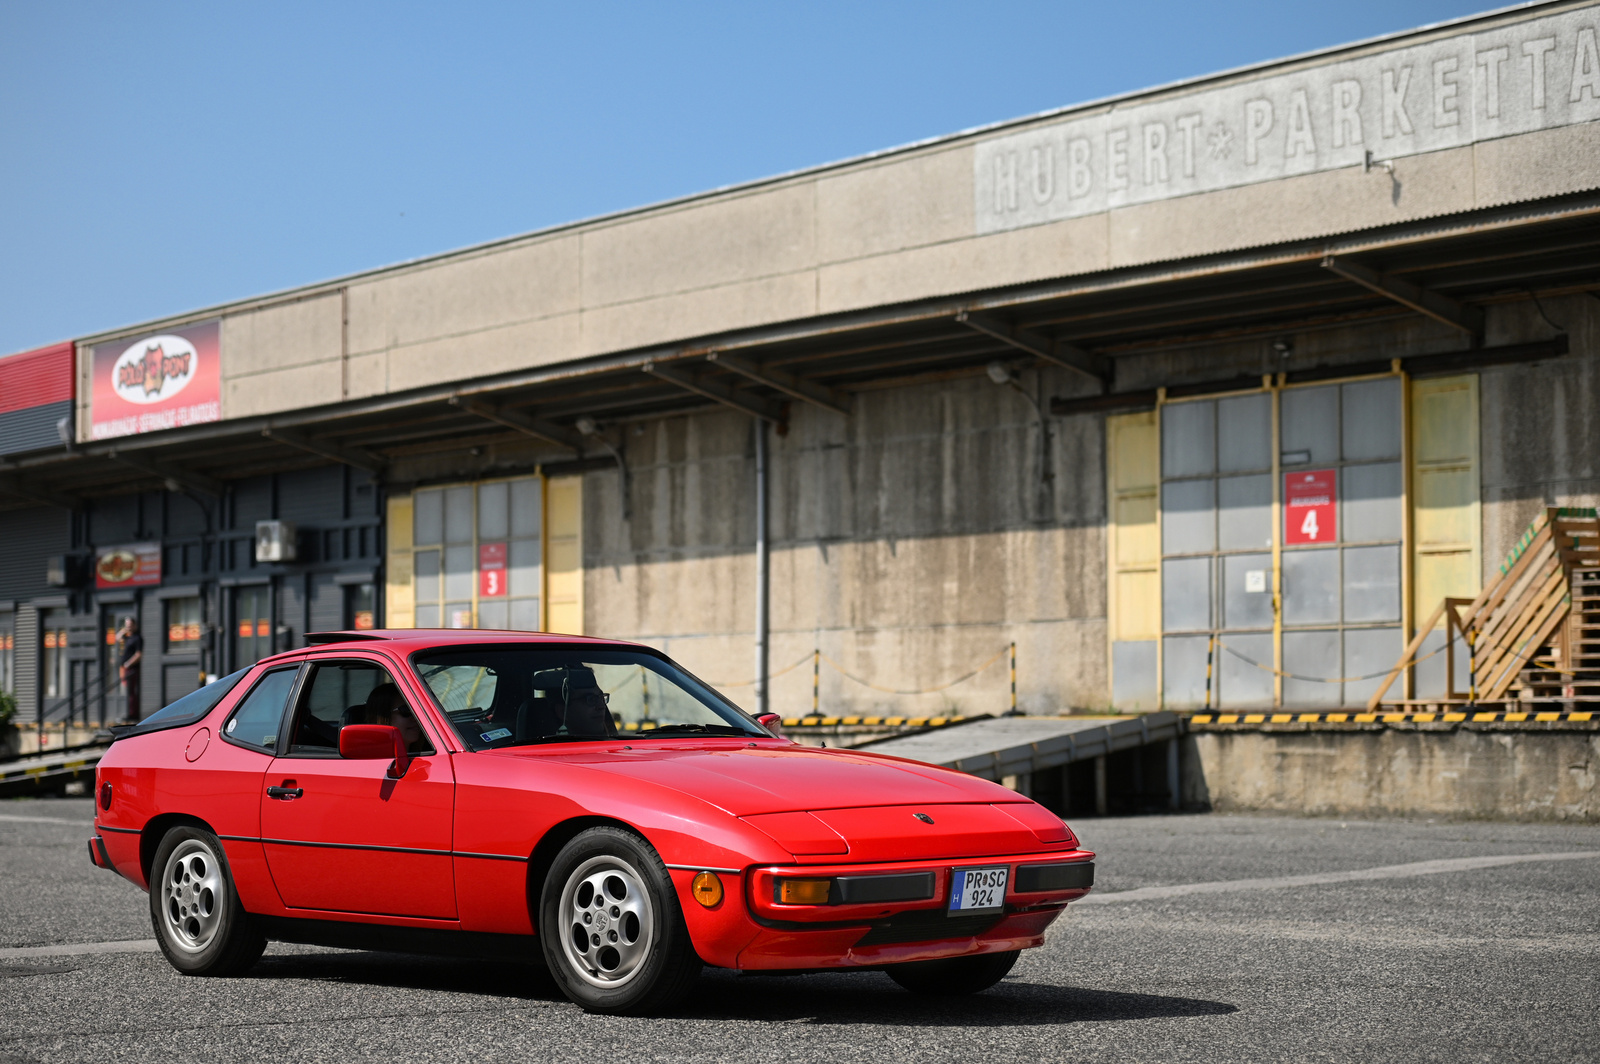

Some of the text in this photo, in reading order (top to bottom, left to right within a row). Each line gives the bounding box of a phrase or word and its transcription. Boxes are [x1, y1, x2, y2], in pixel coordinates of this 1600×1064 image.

[992, 25, 1600, 214] HUBERT PARKETTA
[1301, 509, 1319, 540] 4
[487, 571, 498, 595] 3
[952, 894, 960, 903] H
[971, 889, 994, 907] 924
